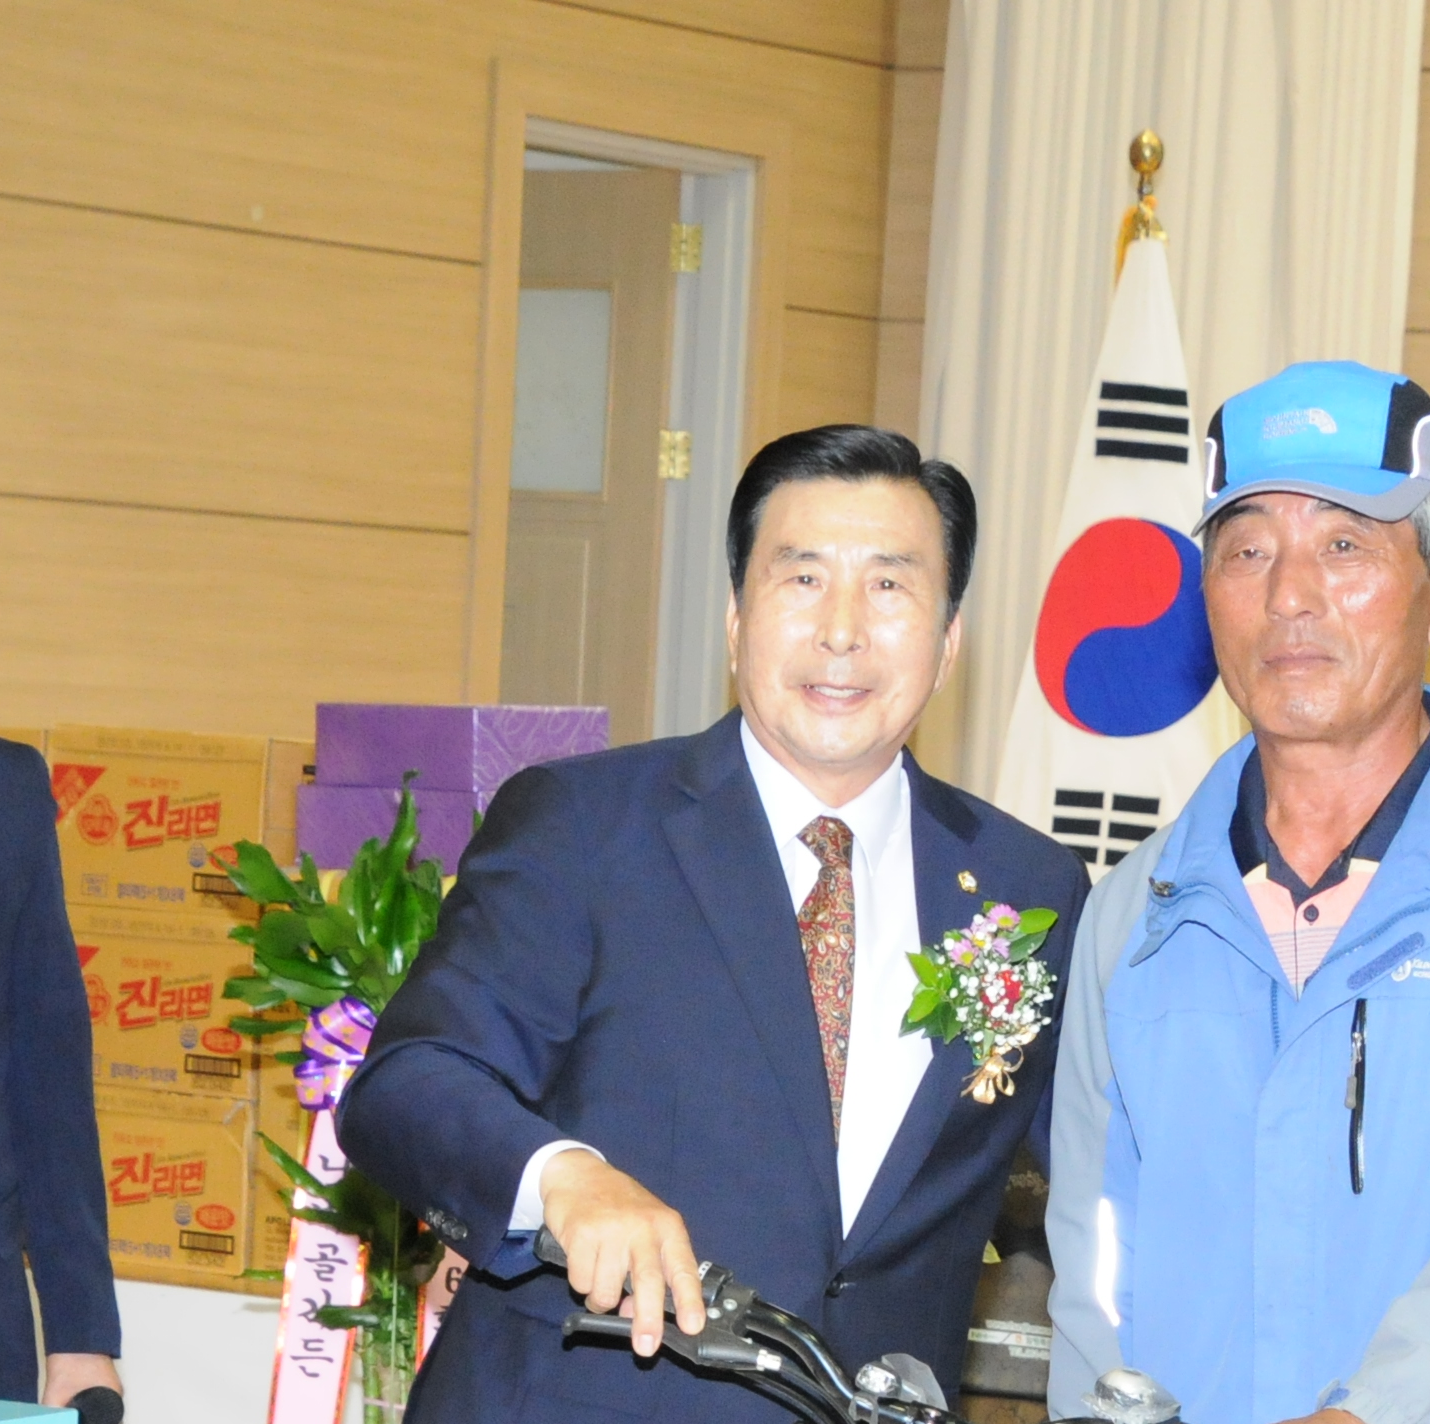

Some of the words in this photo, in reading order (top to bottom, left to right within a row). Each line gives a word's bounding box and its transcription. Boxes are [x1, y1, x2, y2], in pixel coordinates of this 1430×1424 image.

[123, 795, 221, 849] 진라면
[115, 976, 213, 1030] 진라면
[109, 1153, 206, 1206] 진라면
